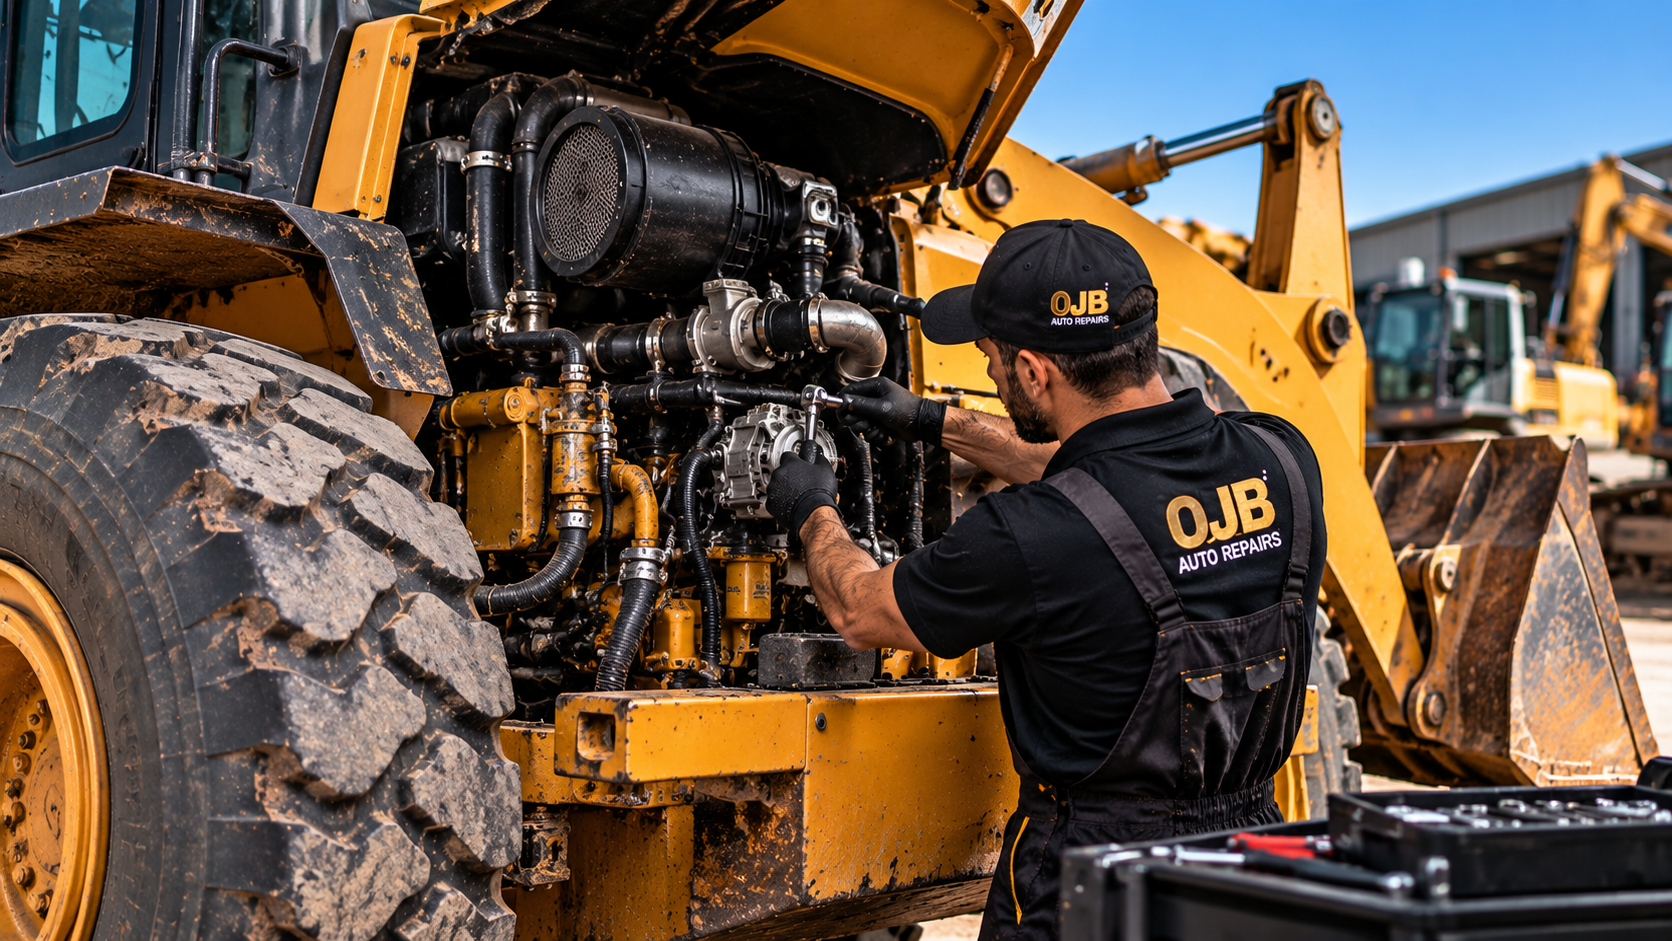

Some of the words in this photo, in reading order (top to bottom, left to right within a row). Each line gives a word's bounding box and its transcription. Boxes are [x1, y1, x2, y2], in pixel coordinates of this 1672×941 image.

[1050, 289, 1109, 316] OJB
[1050, 317, 1073, 326] AUTO
[1074, 315, 1109, 325] REPAIRS
[1165, 477, 1276, 550] OJB
[1178, 548, 1219, 575] AUTO
[1220, 531, 1282, 562] REPAIRS
